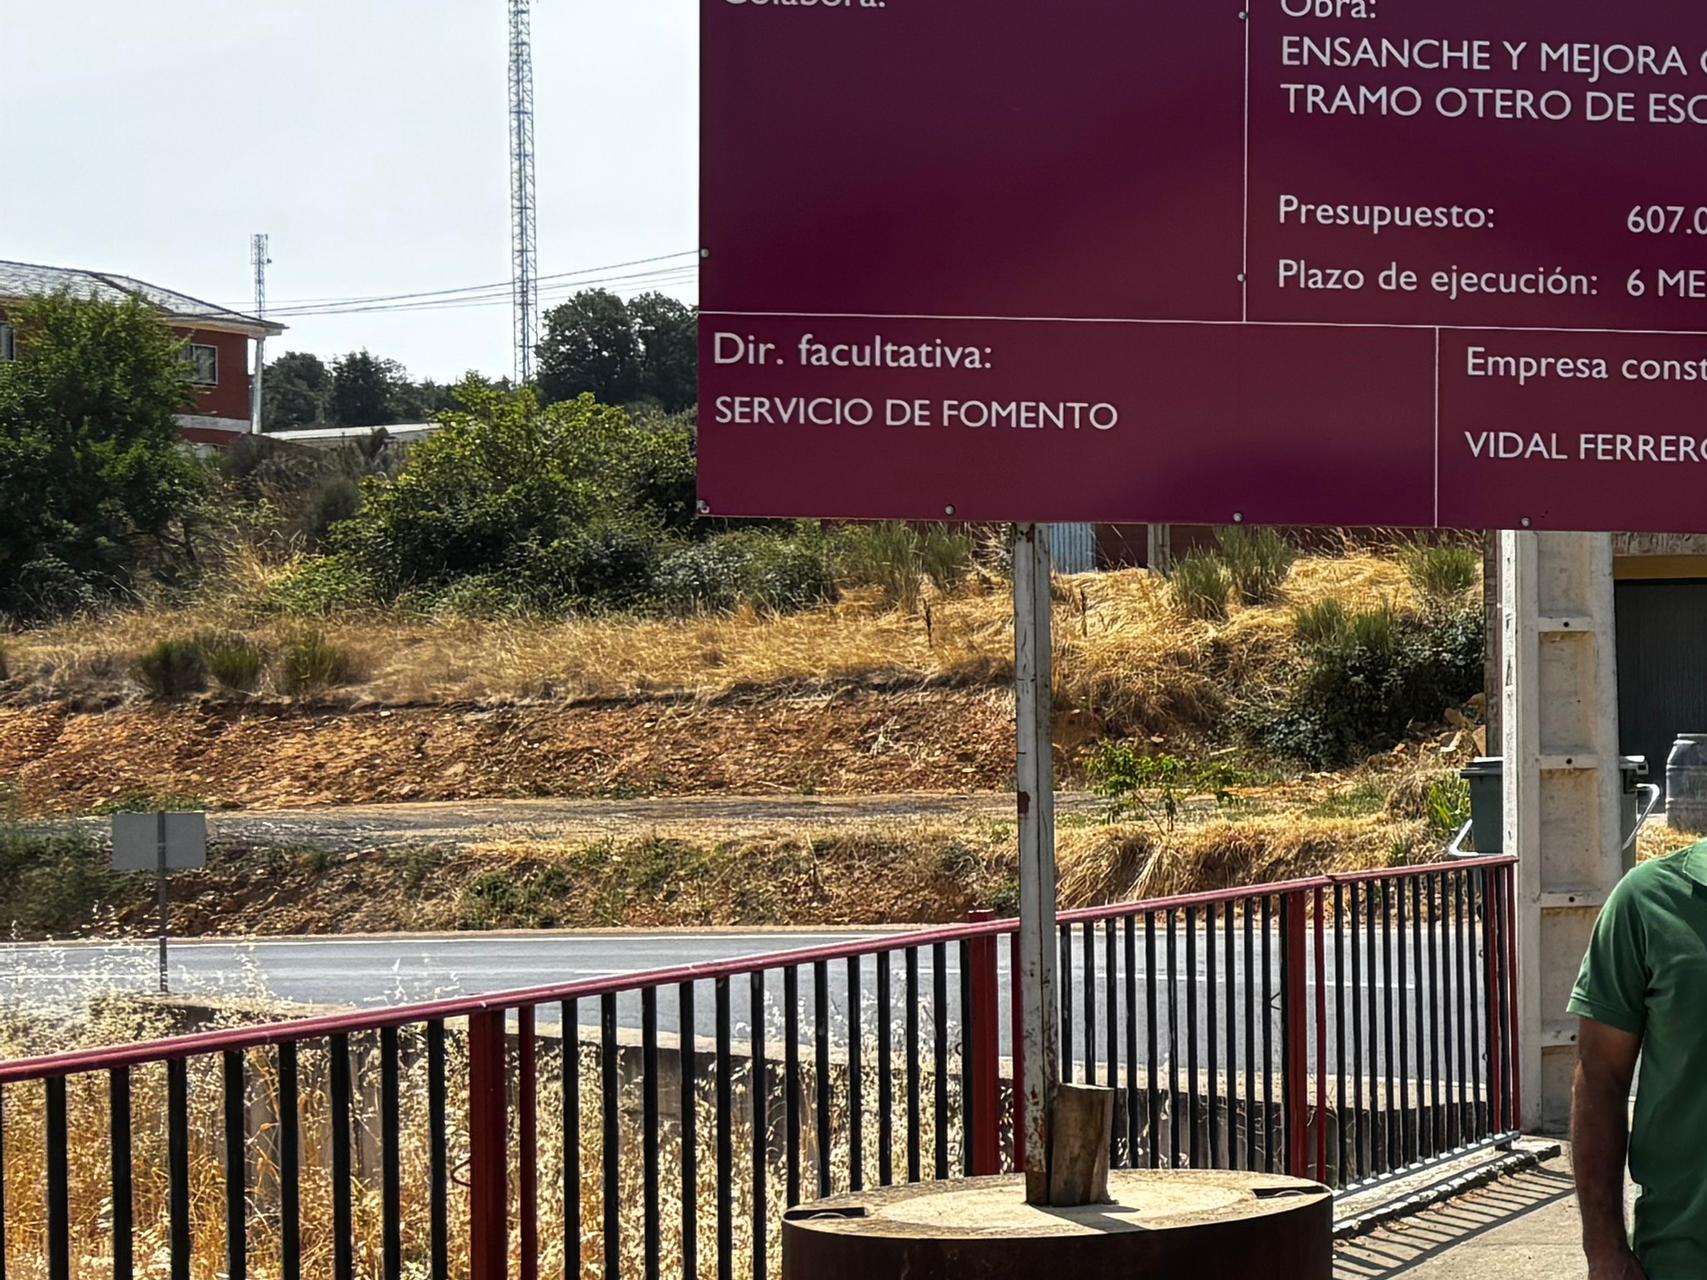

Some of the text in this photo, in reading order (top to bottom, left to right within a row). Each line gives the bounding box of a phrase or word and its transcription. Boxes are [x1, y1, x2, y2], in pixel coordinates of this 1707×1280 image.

[1282, 35, 1491, 70] ENSANCHE
[1502, 40, 1528, 71] Y
[1540, 42, 1688, 83] MEJORA
[1279, 83, 1422, 117] TRAMO
[1435, 87, 1572, 120] OTERO
[1585, 90, 1636, 122] DE
[1279, 194, 1495, 235] Presupuesto:
[1278, 258, 1365, 290] Plazo
[1377, 261, 1418, 291] de
[1430, 263, 1598, 301] ejecución:
[1626, 268, 1645, 297] 6
[714, 331, 992, 369] Dir. facultativa:
[1467, 346, 1609, 386] Empresa
[715, 395, 1118, 431] SERVICIO DE FOMENTO
[1464, 430, 1568, 460] VIDAL
